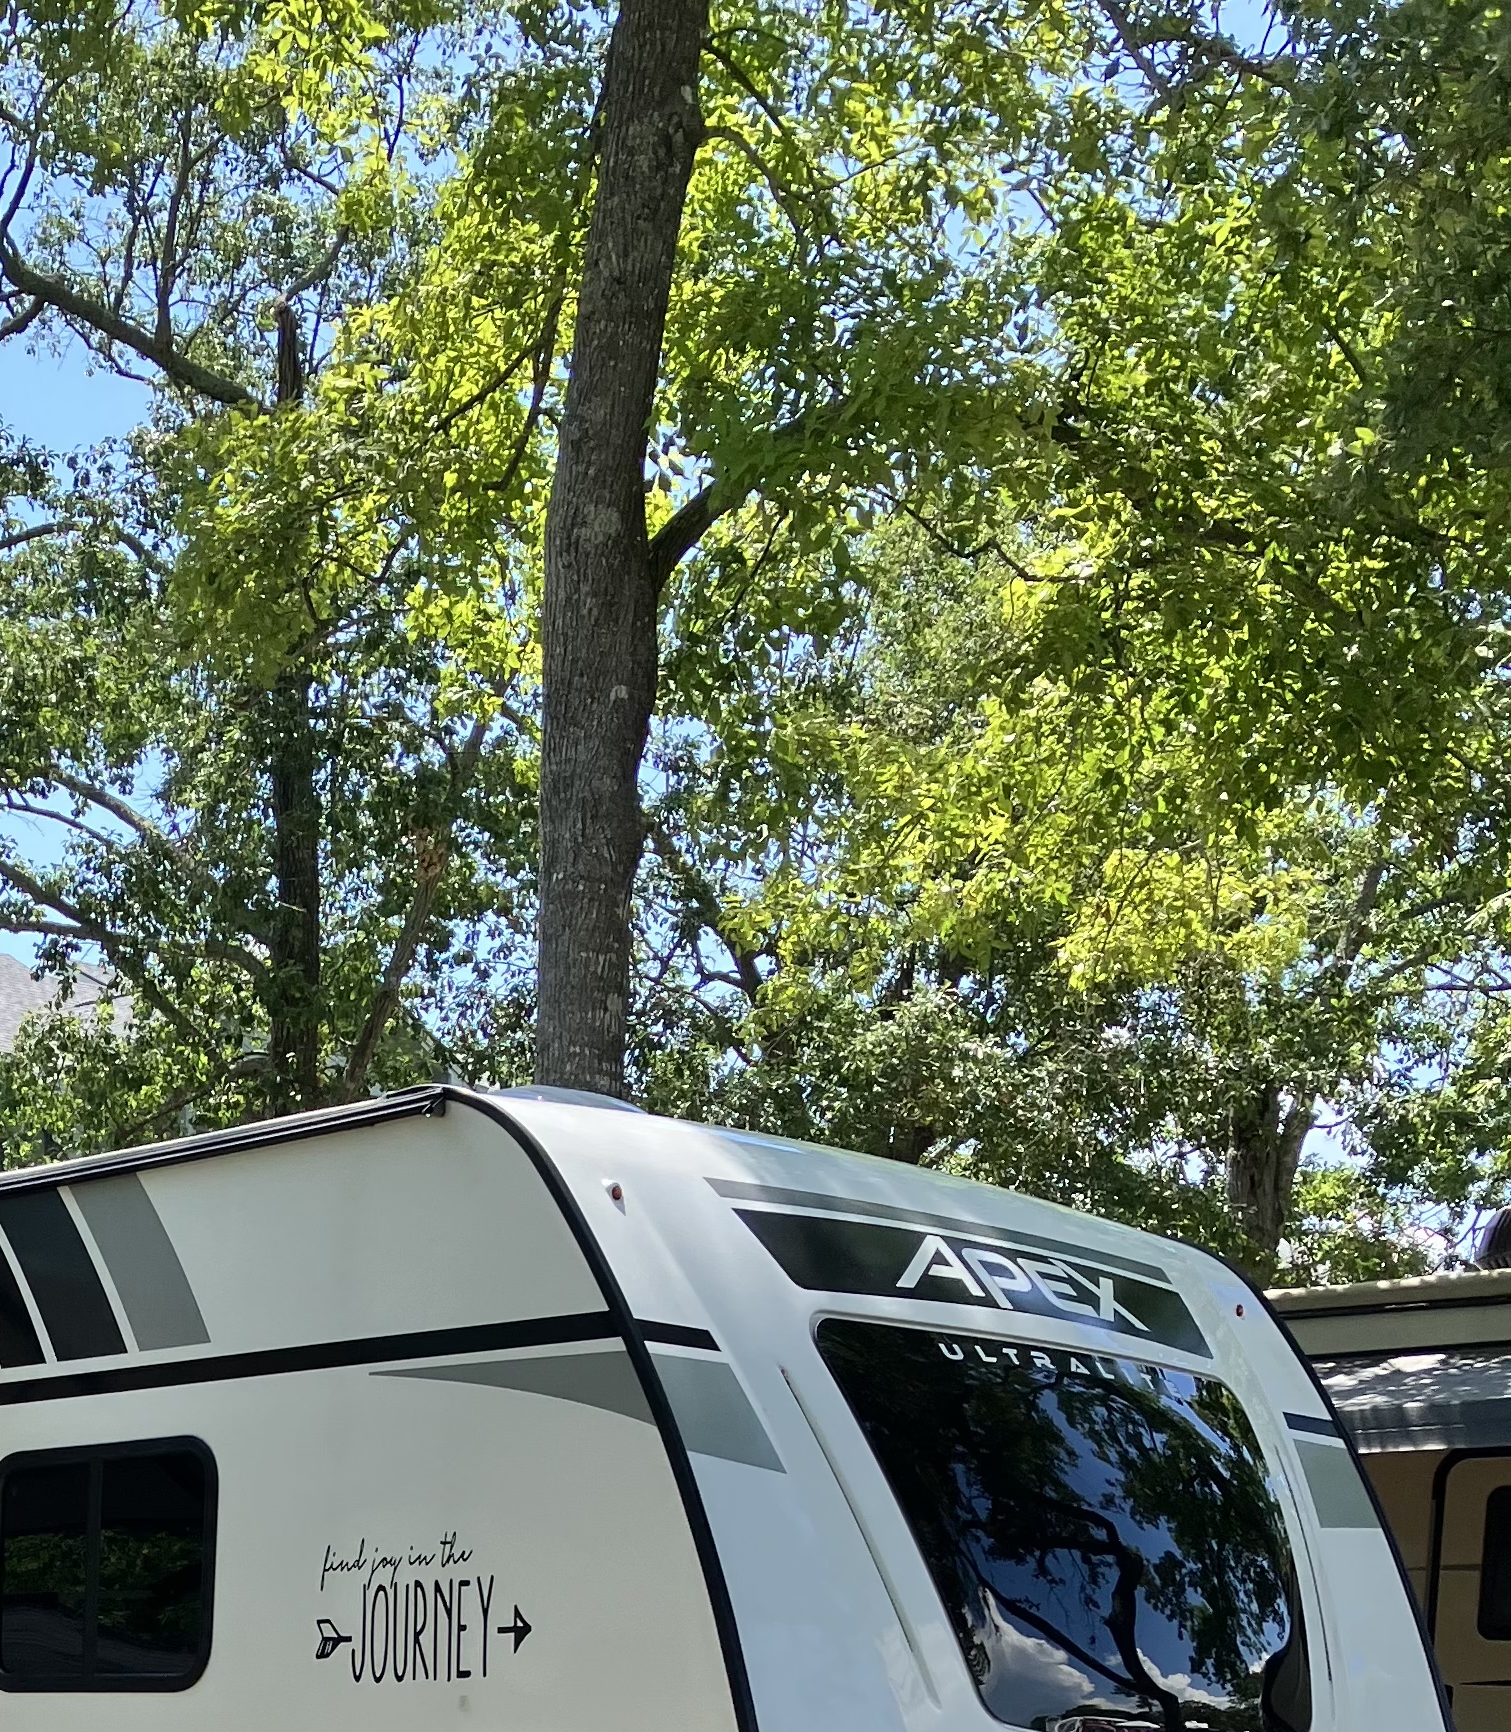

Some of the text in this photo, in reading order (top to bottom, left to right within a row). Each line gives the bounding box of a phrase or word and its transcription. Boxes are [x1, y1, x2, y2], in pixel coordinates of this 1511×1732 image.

[895, 1234, 1151, 1332] APEX
[938, 1342, 1182, 1399] ULTRALITE
[320, 1531, 473, 1591] find joy in the
[351, 1574, 494, 1684] JOURNEY
